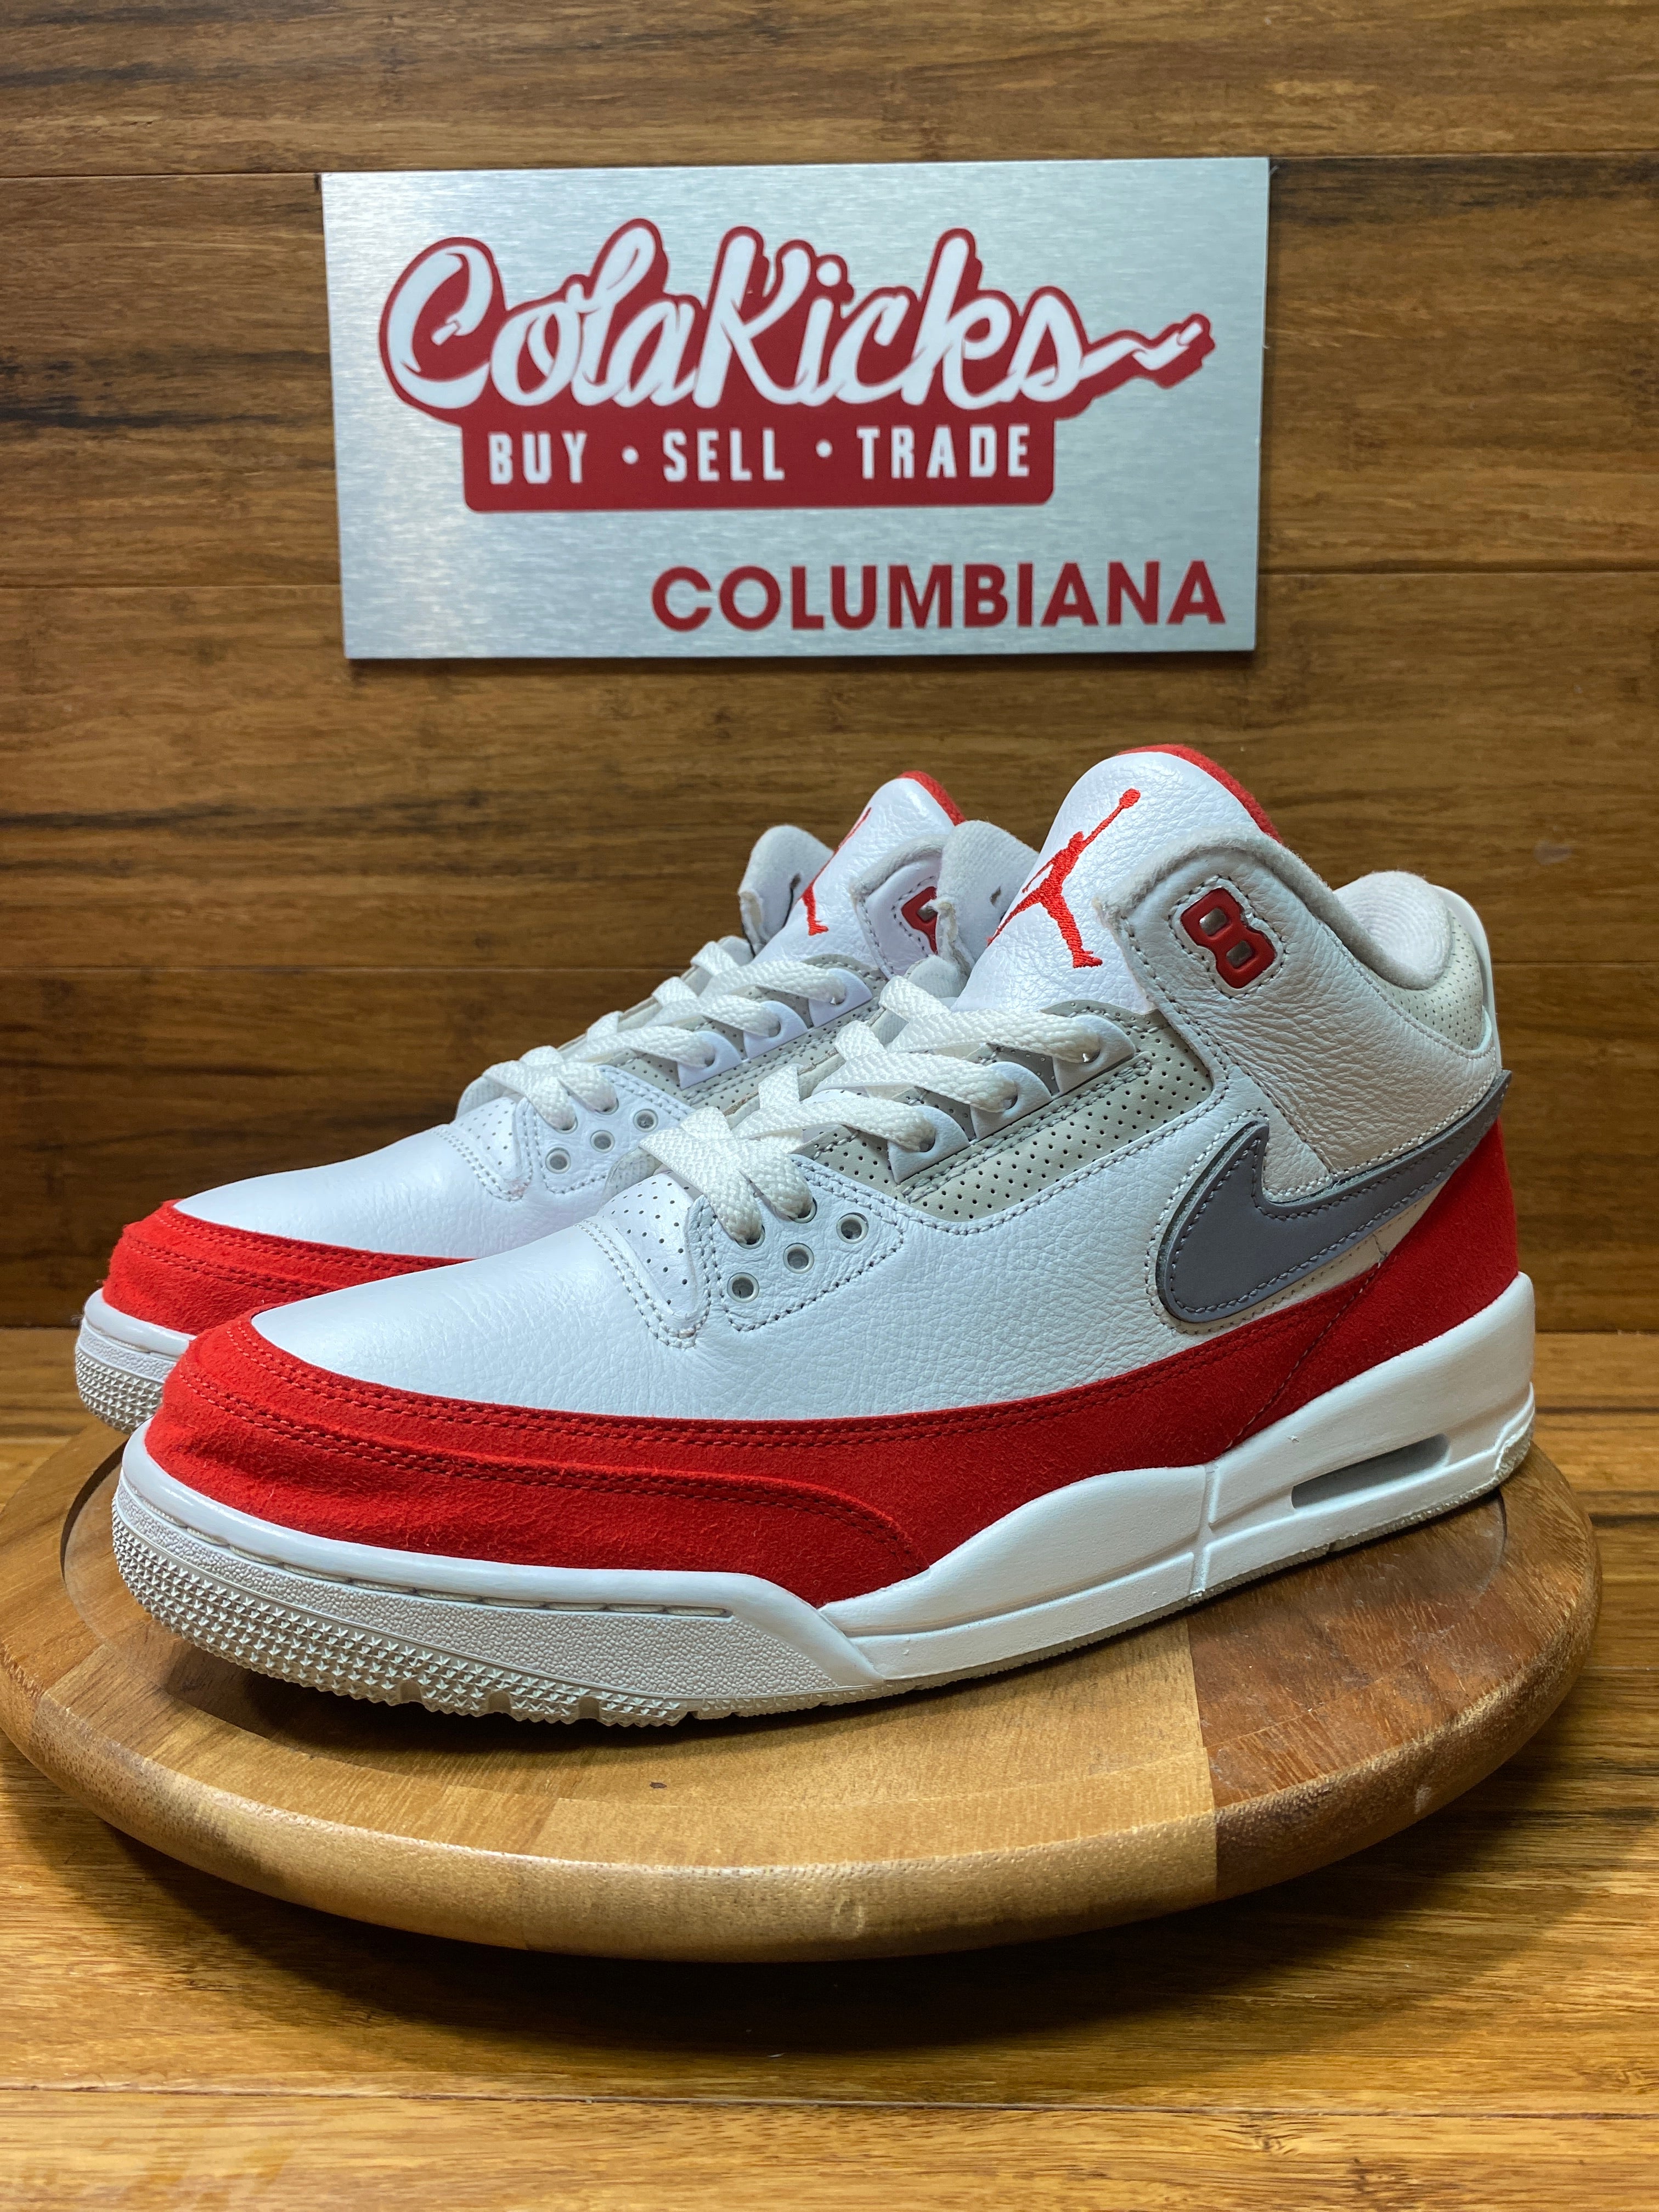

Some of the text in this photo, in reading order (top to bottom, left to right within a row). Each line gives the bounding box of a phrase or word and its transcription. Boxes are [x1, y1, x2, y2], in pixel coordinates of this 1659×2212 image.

[386, 225, 1204, 410] ColaKicks
[488, 425, 1030, 484] BUY SELL TRADE
[651, 560, 1225, 631] COLUMBIANA
